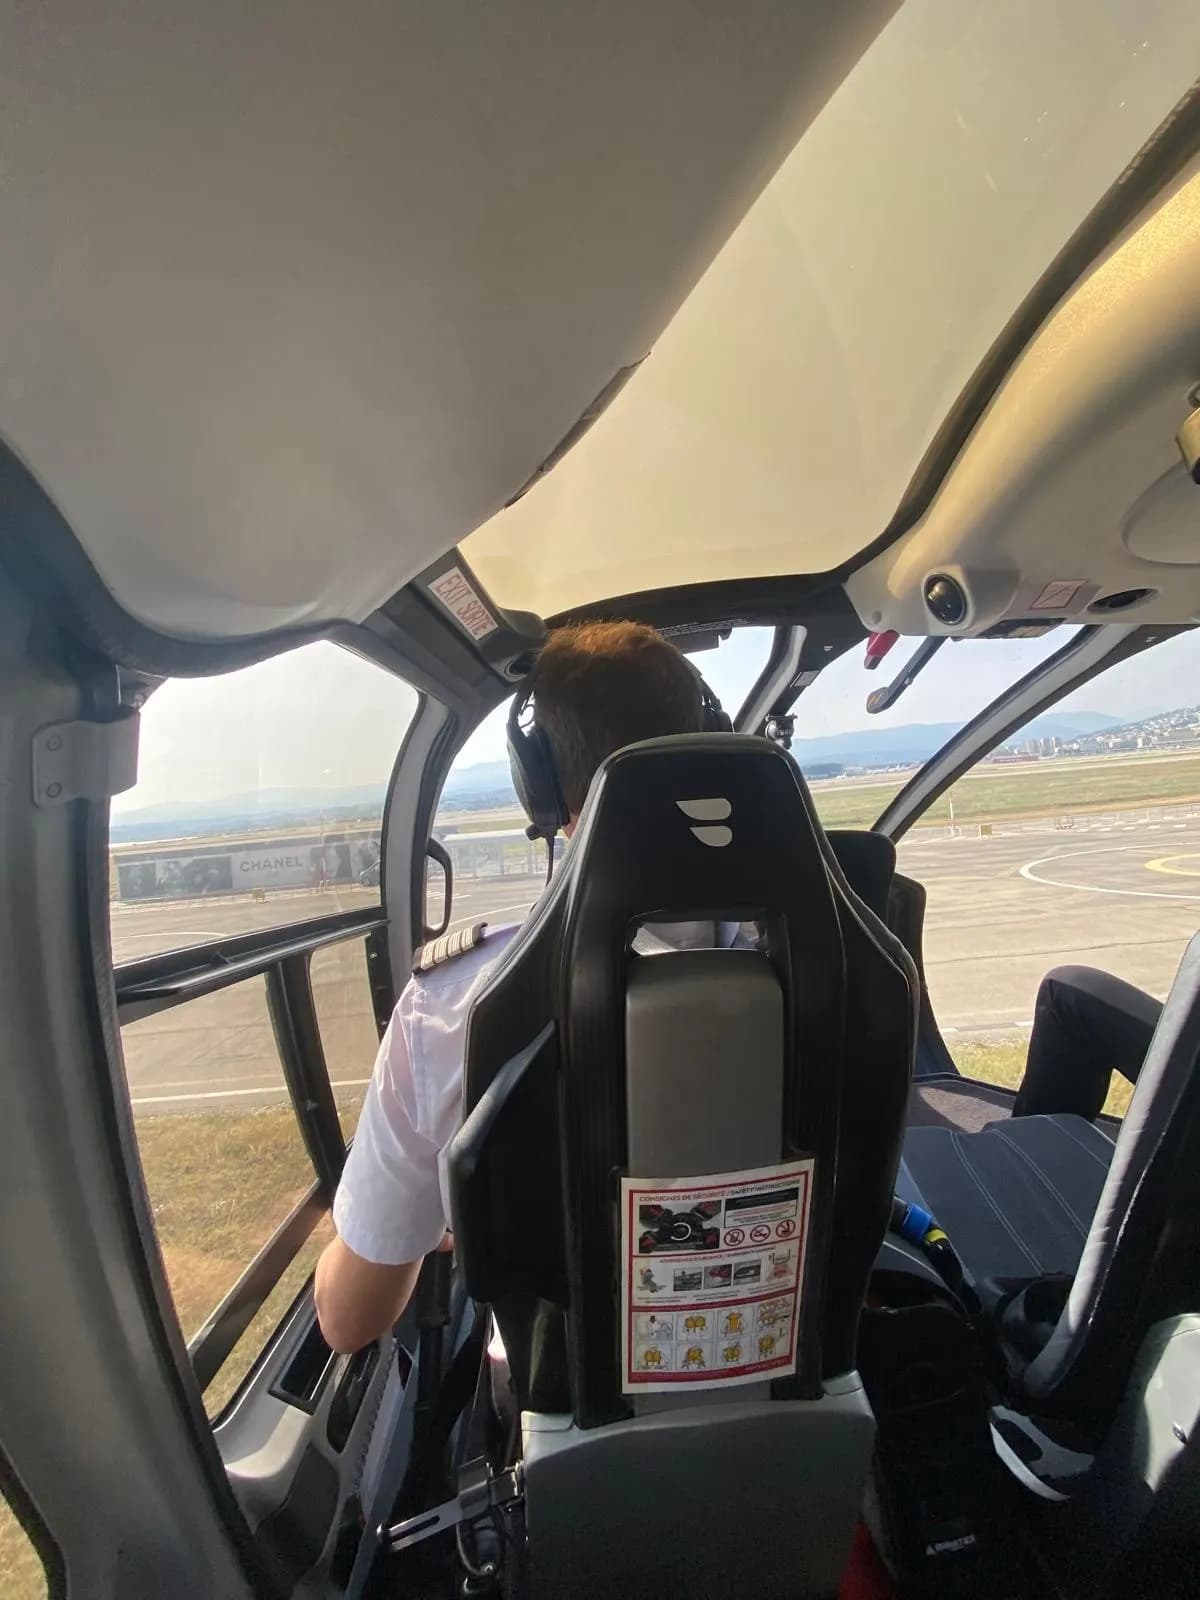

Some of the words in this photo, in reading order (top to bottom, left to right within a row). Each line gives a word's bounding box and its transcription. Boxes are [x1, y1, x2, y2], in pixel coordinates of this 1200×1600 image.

[436, 574, 472, 605] EXIT
[457, 600, 495, 636] SORTIE
[240, 855, 303, 872] CHANEL
[731, 1186, 754, 1196] SAFETY
